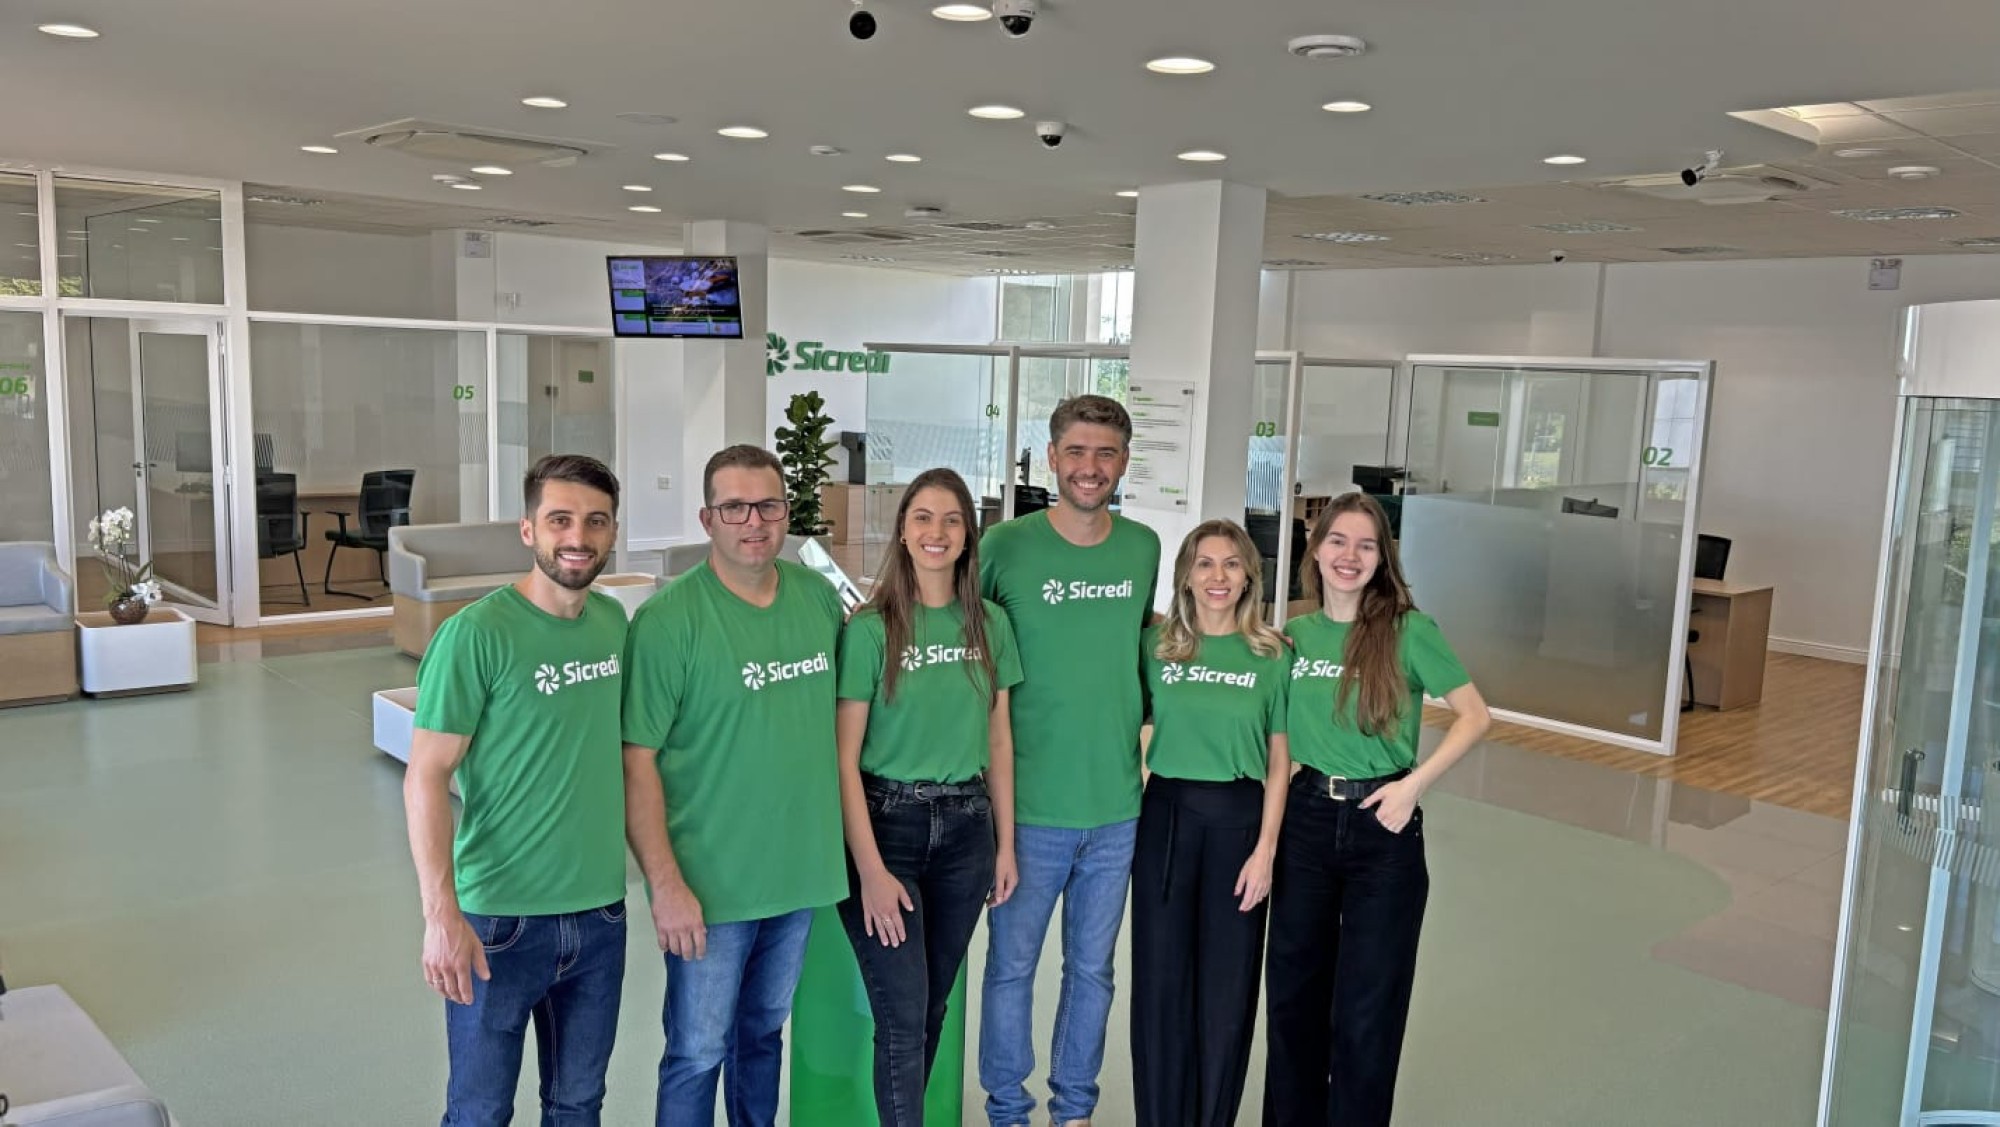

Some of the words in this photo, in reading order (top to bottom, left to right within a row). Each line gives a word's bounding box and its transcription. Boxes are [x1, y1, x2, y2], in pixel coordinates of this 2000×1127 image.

[793, 341, 891, 374] Sicredi
[0, 376, 28, 395] 06
[453, 385, 474, 400] 05
[1255, 421, 1275, 437] 03
[1643, 446, 1673, 466] 02
[1068, 579, 1133, 599] Sicredi
[562, 653, 620, 685] Sicredi
[767, 651, 829, 682] Sicredi
[1308, 659, 1346, 678] Sicr
[1185, 665, 1257, 689] Sicredi
